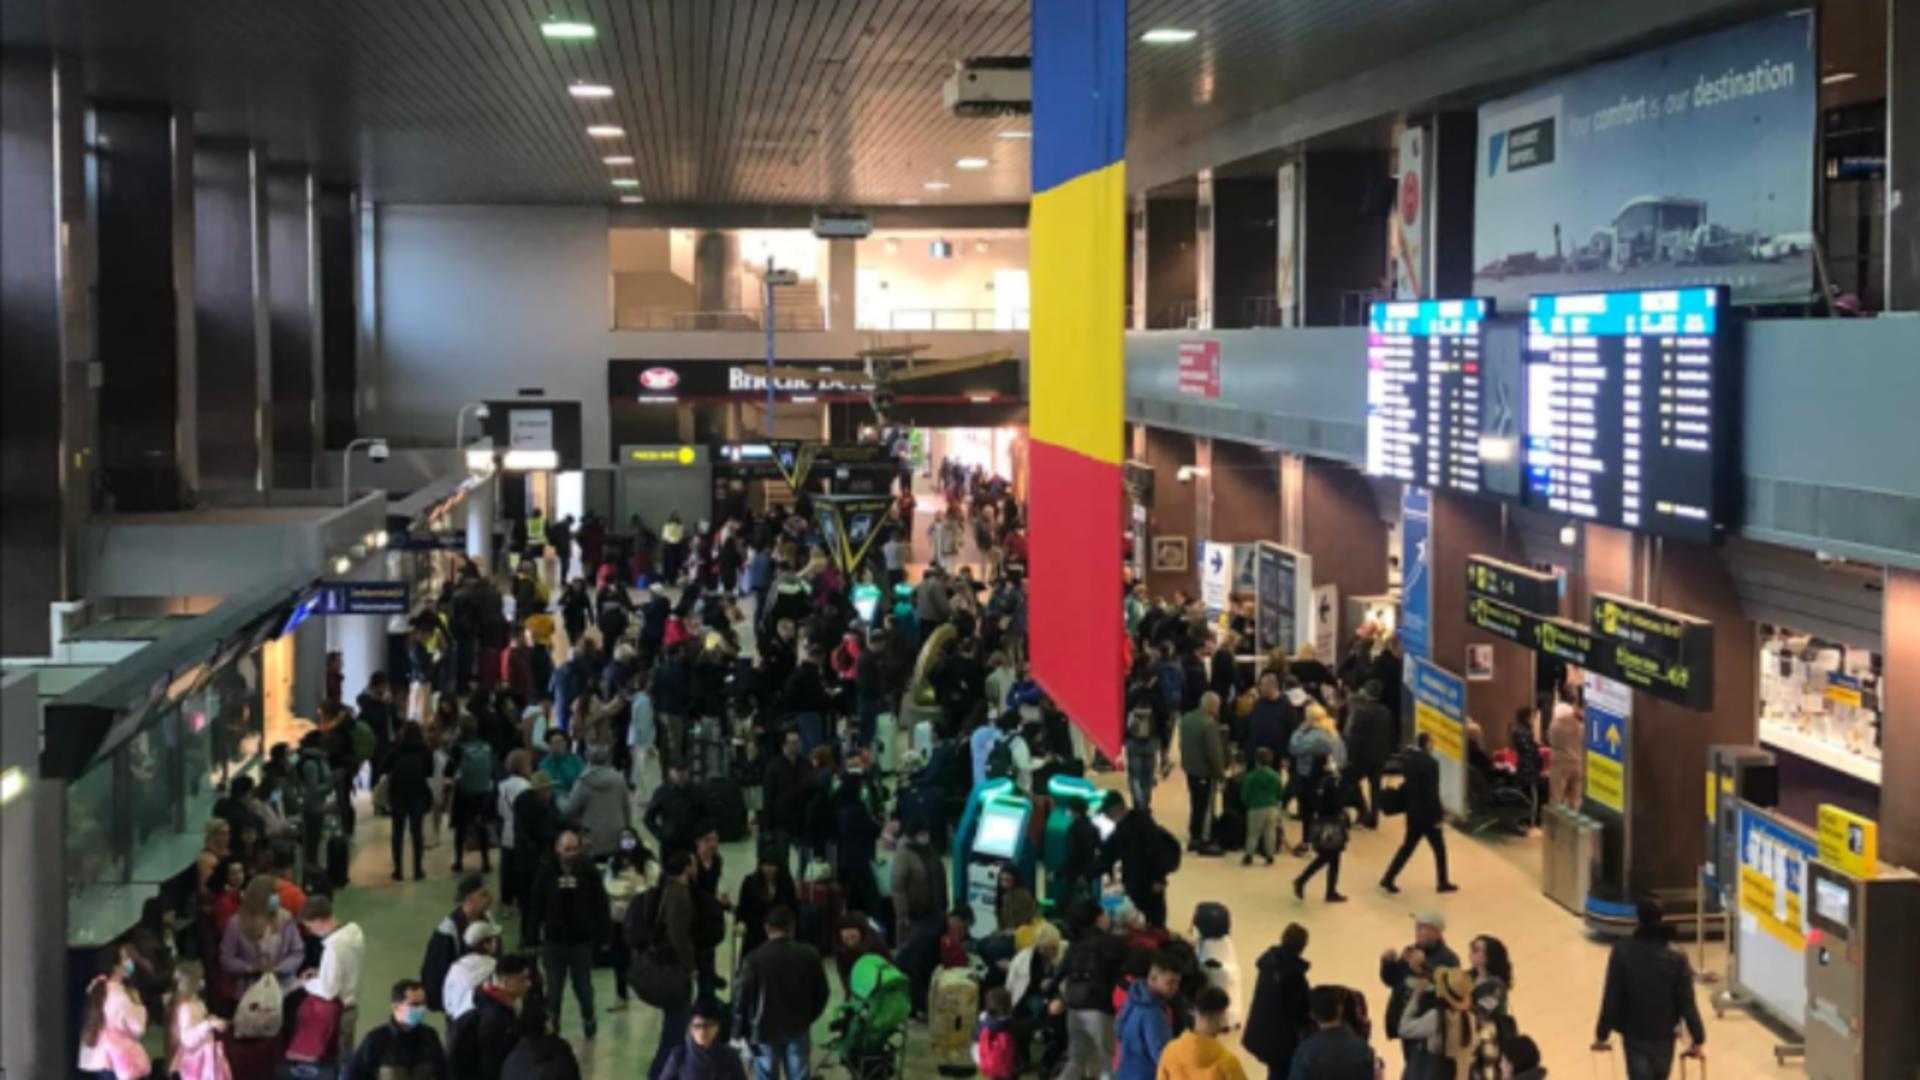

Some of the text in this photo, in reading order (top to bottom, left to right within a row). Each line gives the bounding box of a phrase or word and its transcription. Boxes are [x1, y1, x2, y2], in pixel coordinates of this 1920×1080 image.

[1593, 94, 1646, 132] comfort
[1663, 89, 1690, 115] our
[1693, 58, 1795, 108] destination
